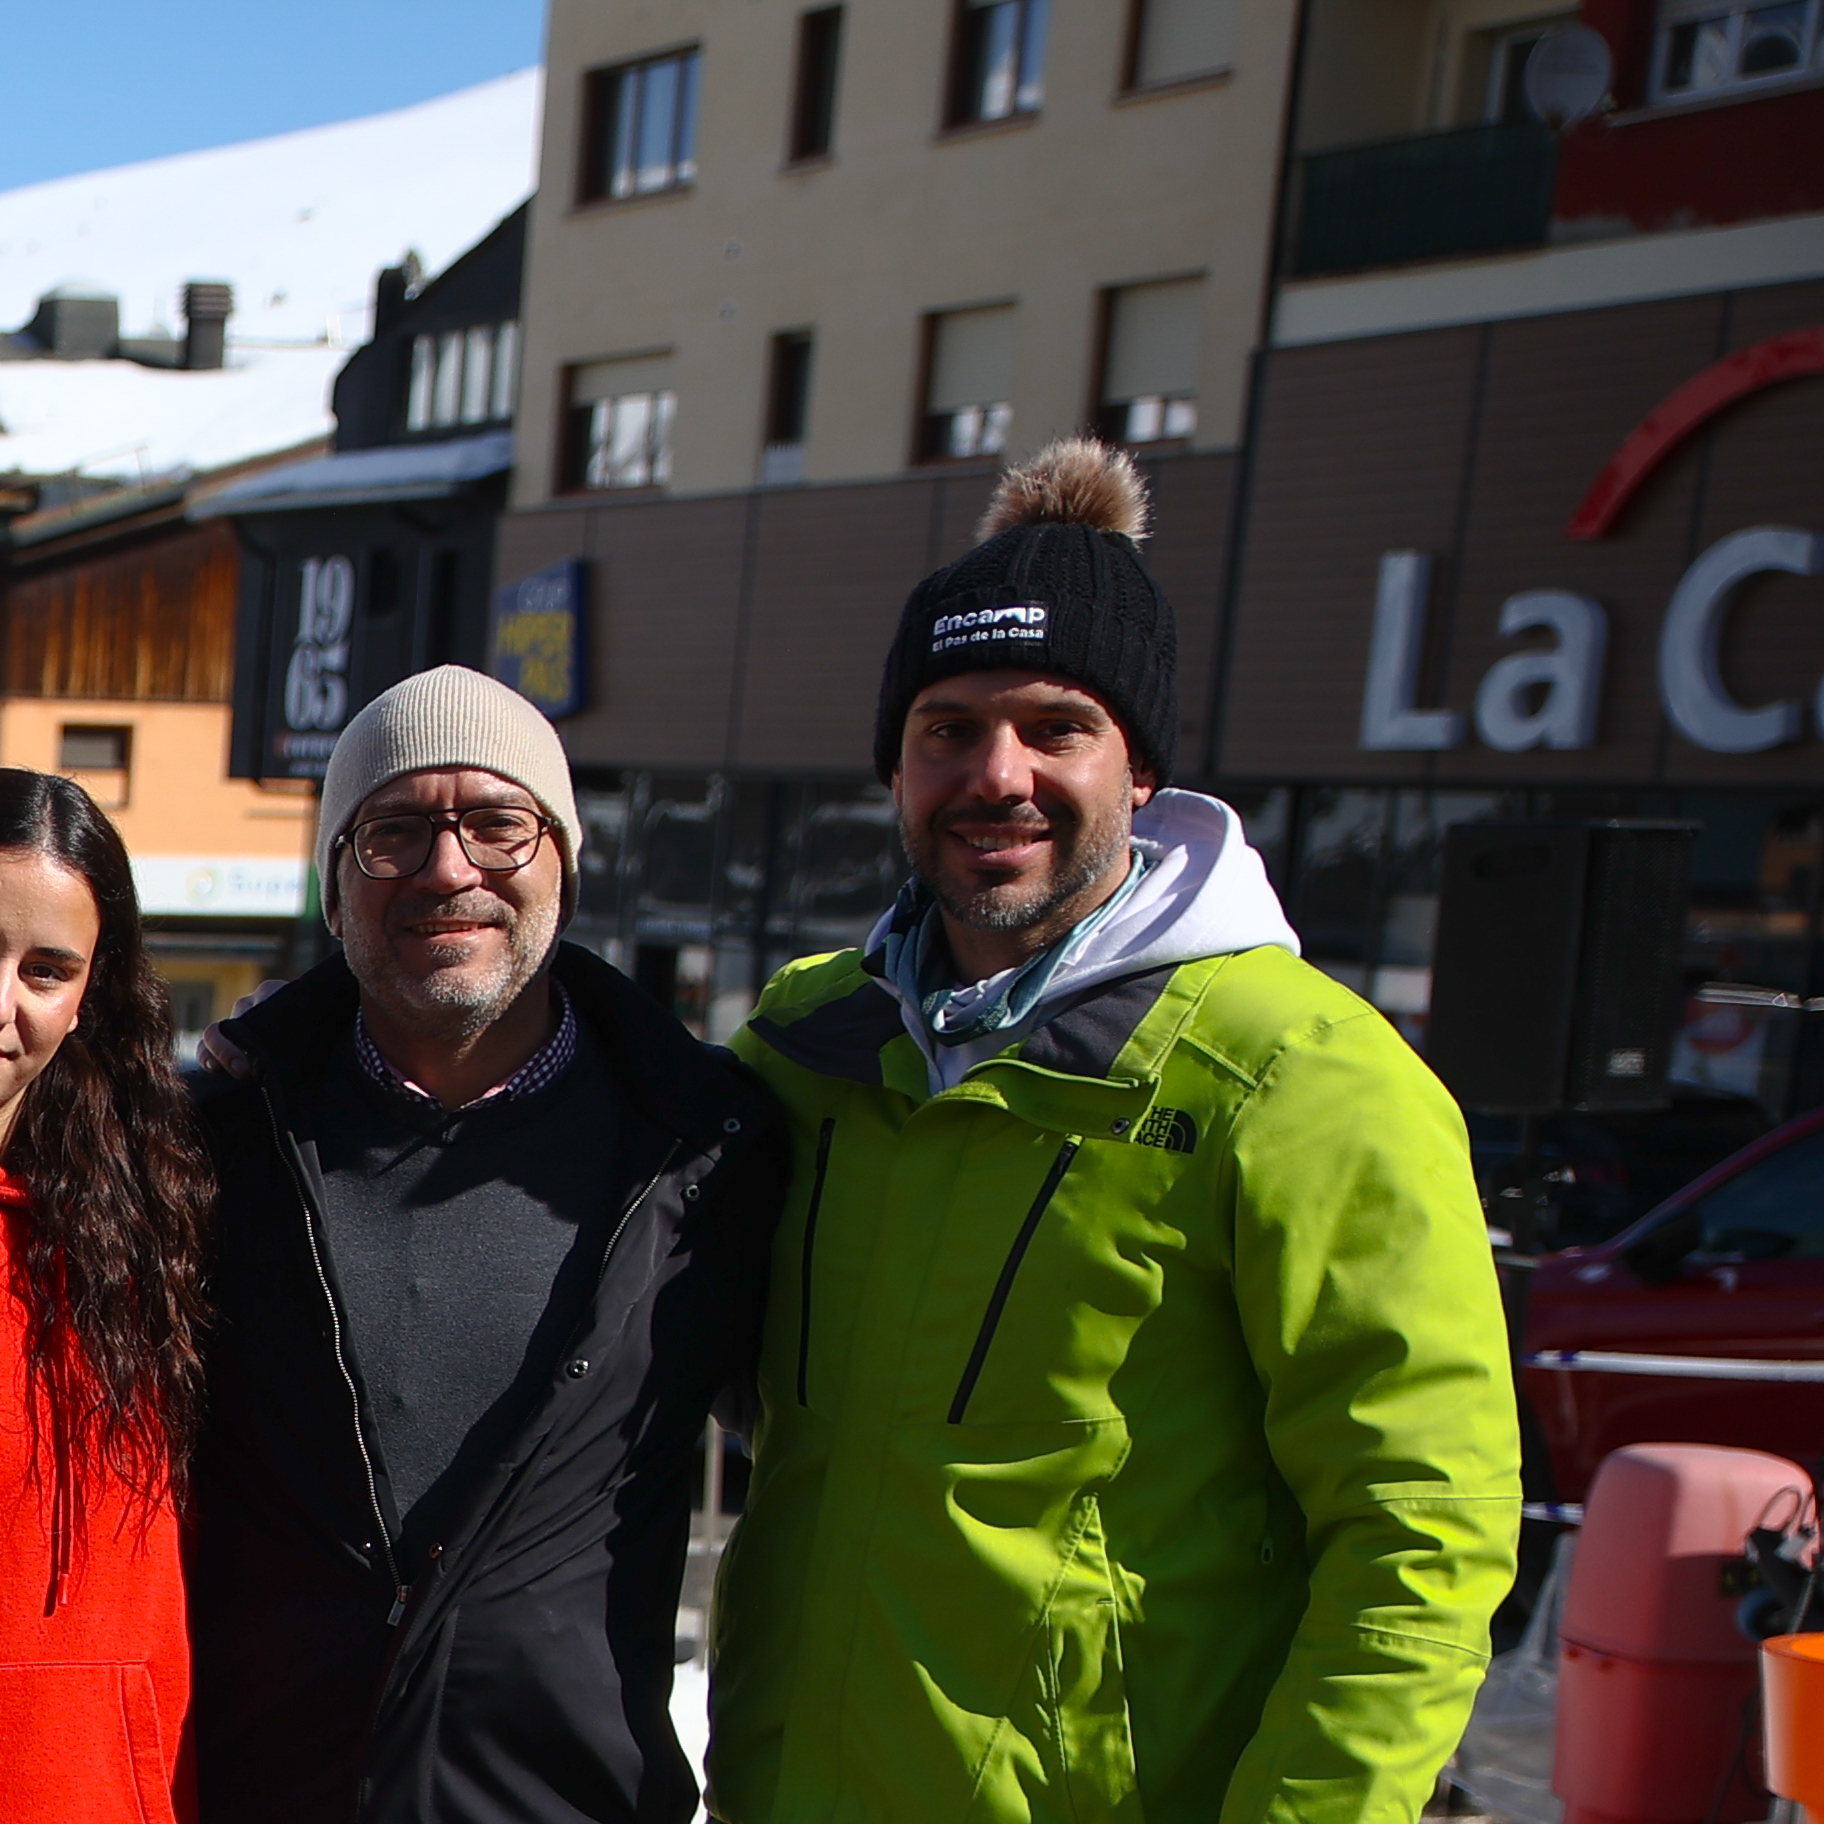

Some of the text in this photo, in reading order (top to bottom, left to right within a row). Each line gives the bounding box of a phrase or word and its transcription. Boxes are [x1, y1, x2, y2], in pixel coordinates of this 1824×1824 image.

[297, 553, 356, 647] 19
[932, 606, 1045, 636] Encamp
[932, 627, 1044, 653] El Pas de la Casa
[1359, 524, 1824, 754] La C
[284, 642, 350, 732] 65
[1134, 1131, 1167, 1148] ACE
